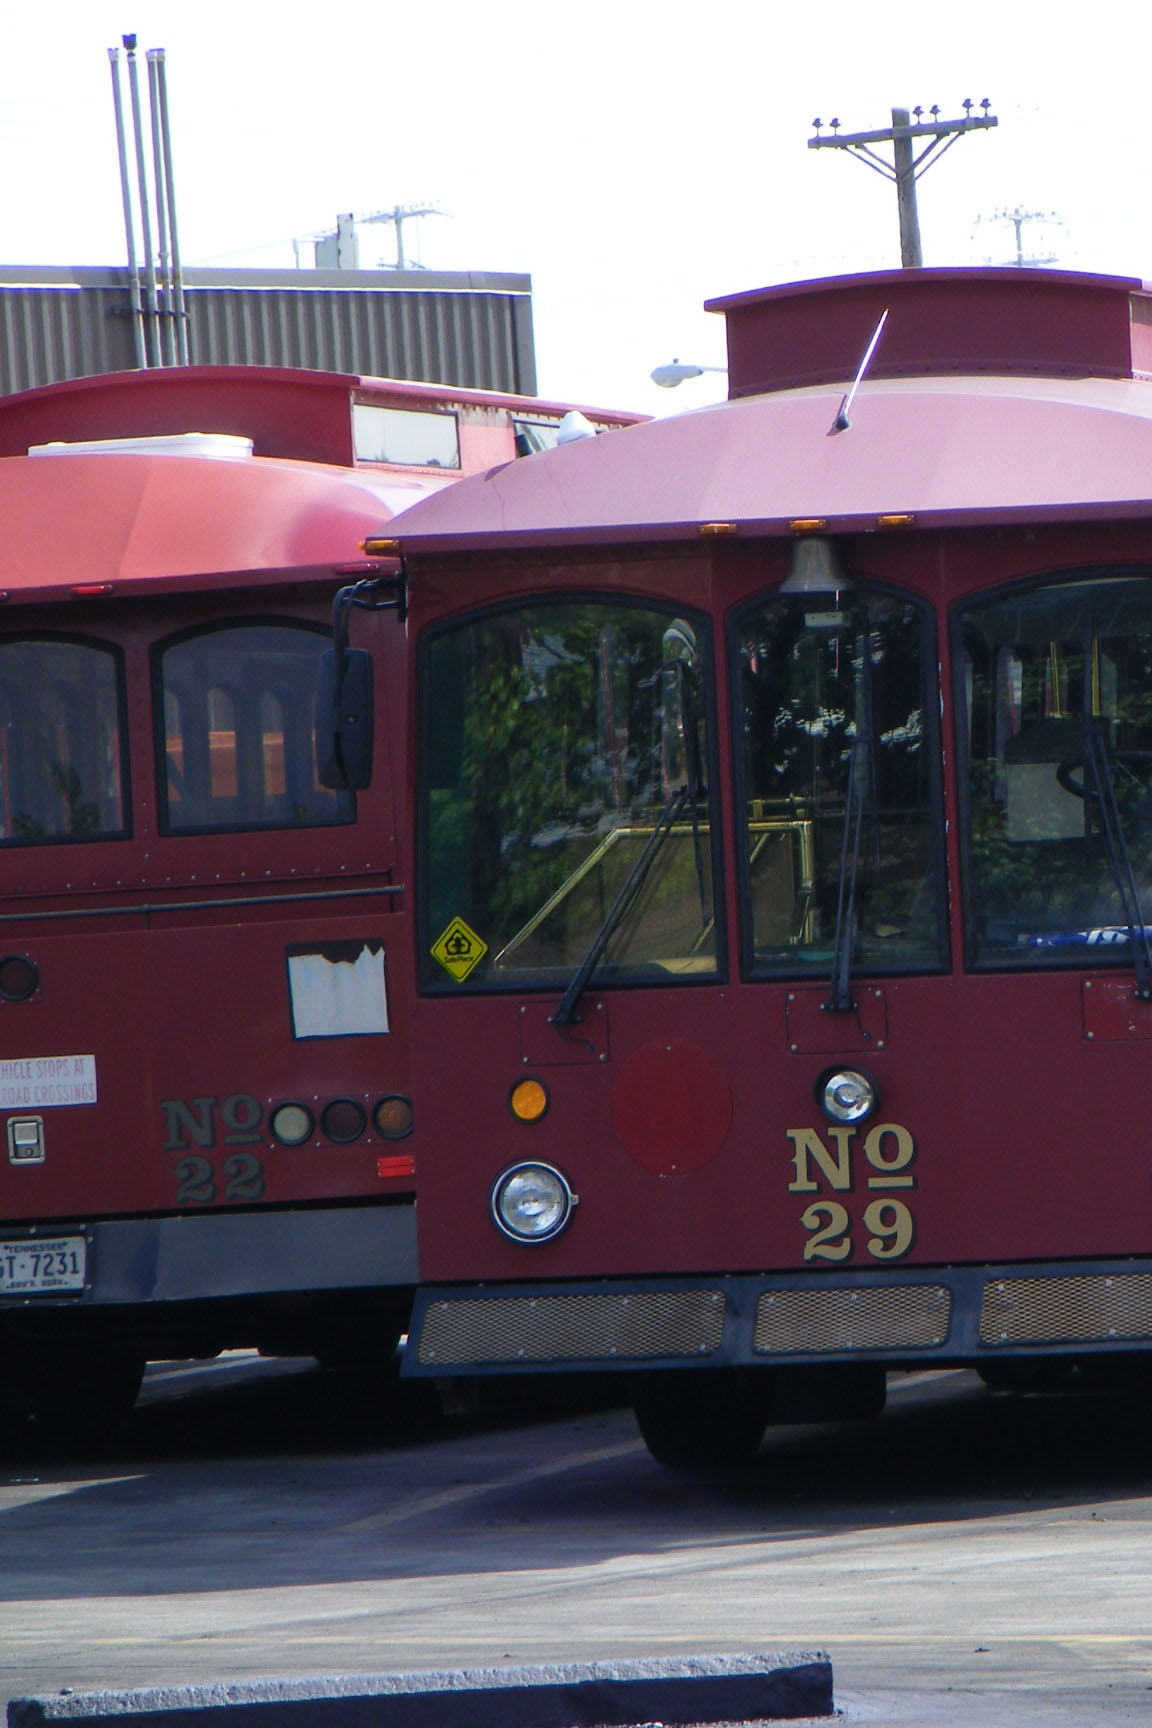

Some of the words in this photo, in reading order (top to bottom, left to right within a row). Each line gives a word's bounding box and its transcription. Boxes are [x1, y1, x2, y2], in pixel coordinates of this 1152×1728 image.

[0, 1061, 32, 1080] HICLE
[36, 1059, 69, 1079] STOPS
[74, 1058, 84, 1076] AT
[0, 1085, 30, 1105] ROAD
[35, 1082, 96, 1103] CROSSINGS
[172, 1152, 265, 1204] 22
[800, 1198, 914, 1262] 29
